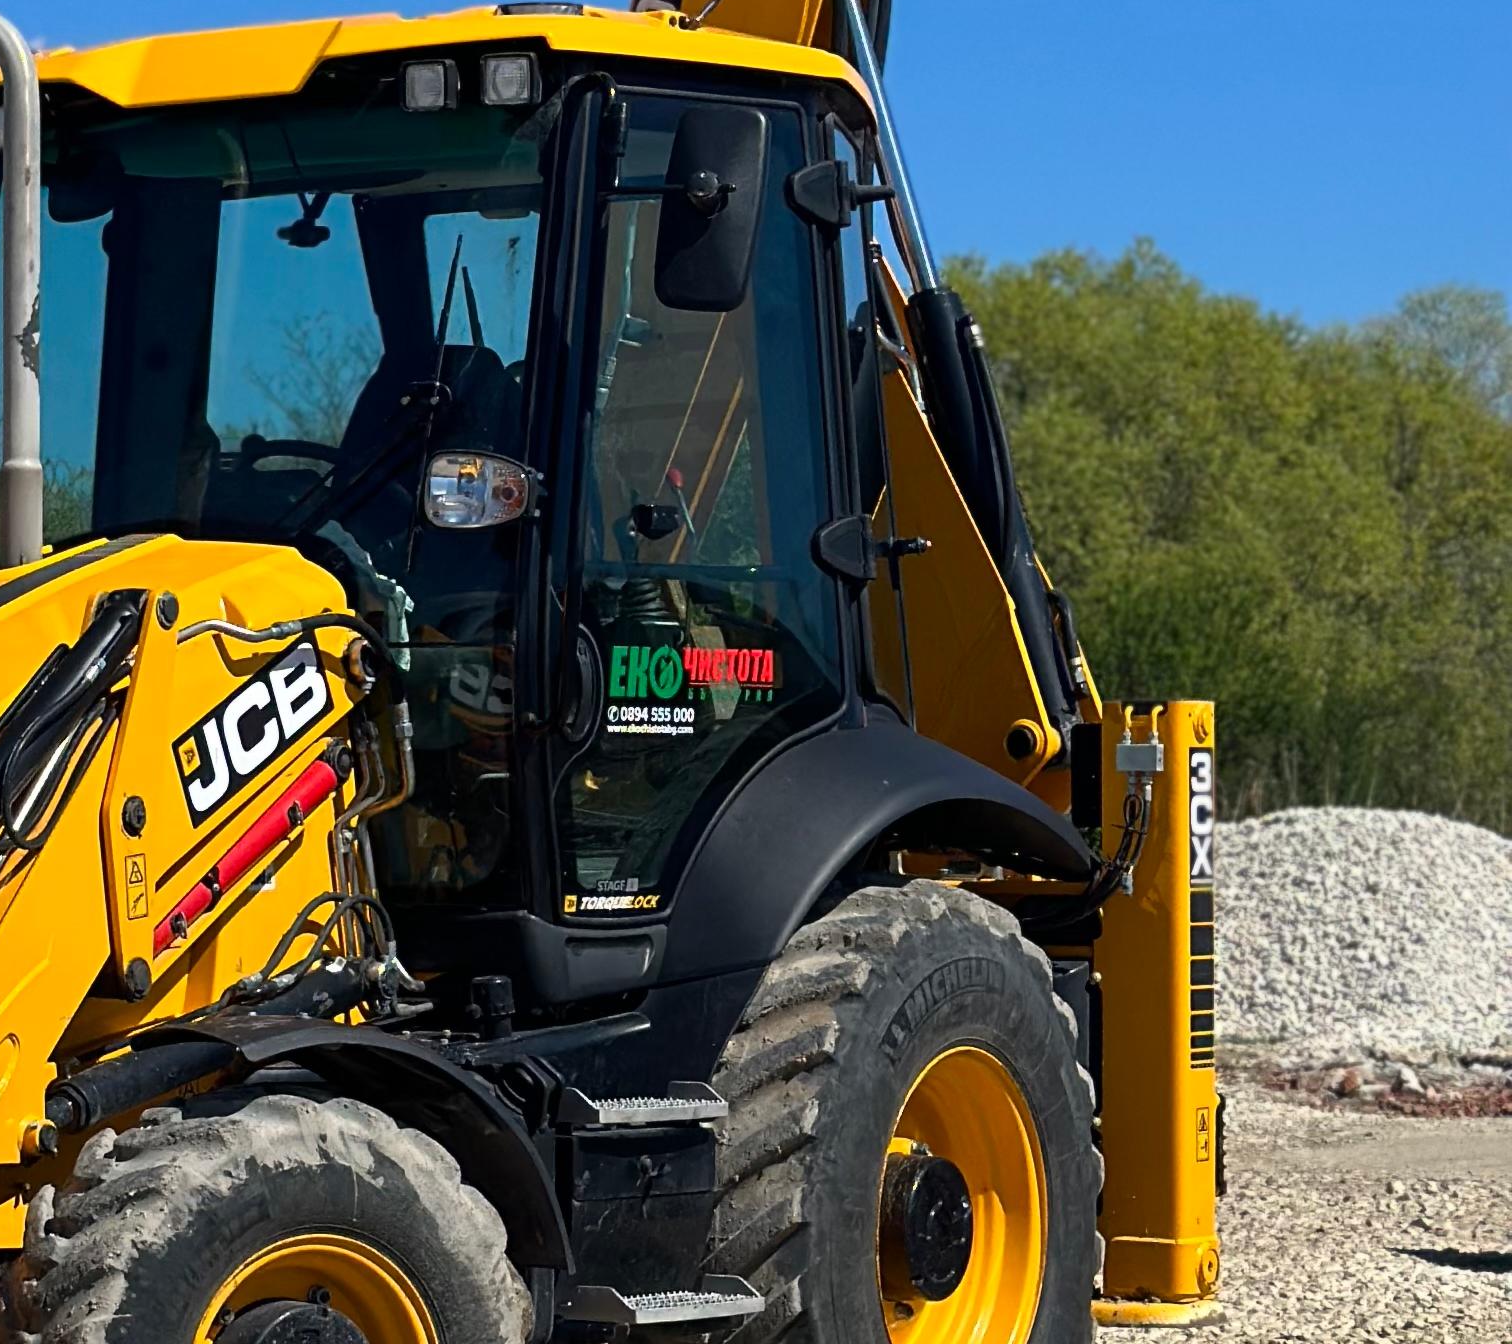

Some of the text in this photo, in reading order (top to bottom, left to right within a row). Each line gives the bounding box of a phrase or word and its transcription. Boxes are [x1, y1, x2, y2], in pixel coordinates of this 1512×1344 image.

[683, 646, 775, 684] ЧИСТОТА
[188, 642, 328, 813] JCB
[620, 706, 695, 723] 0894 555 000
[1190, 752, 1213, 876] 3CX
